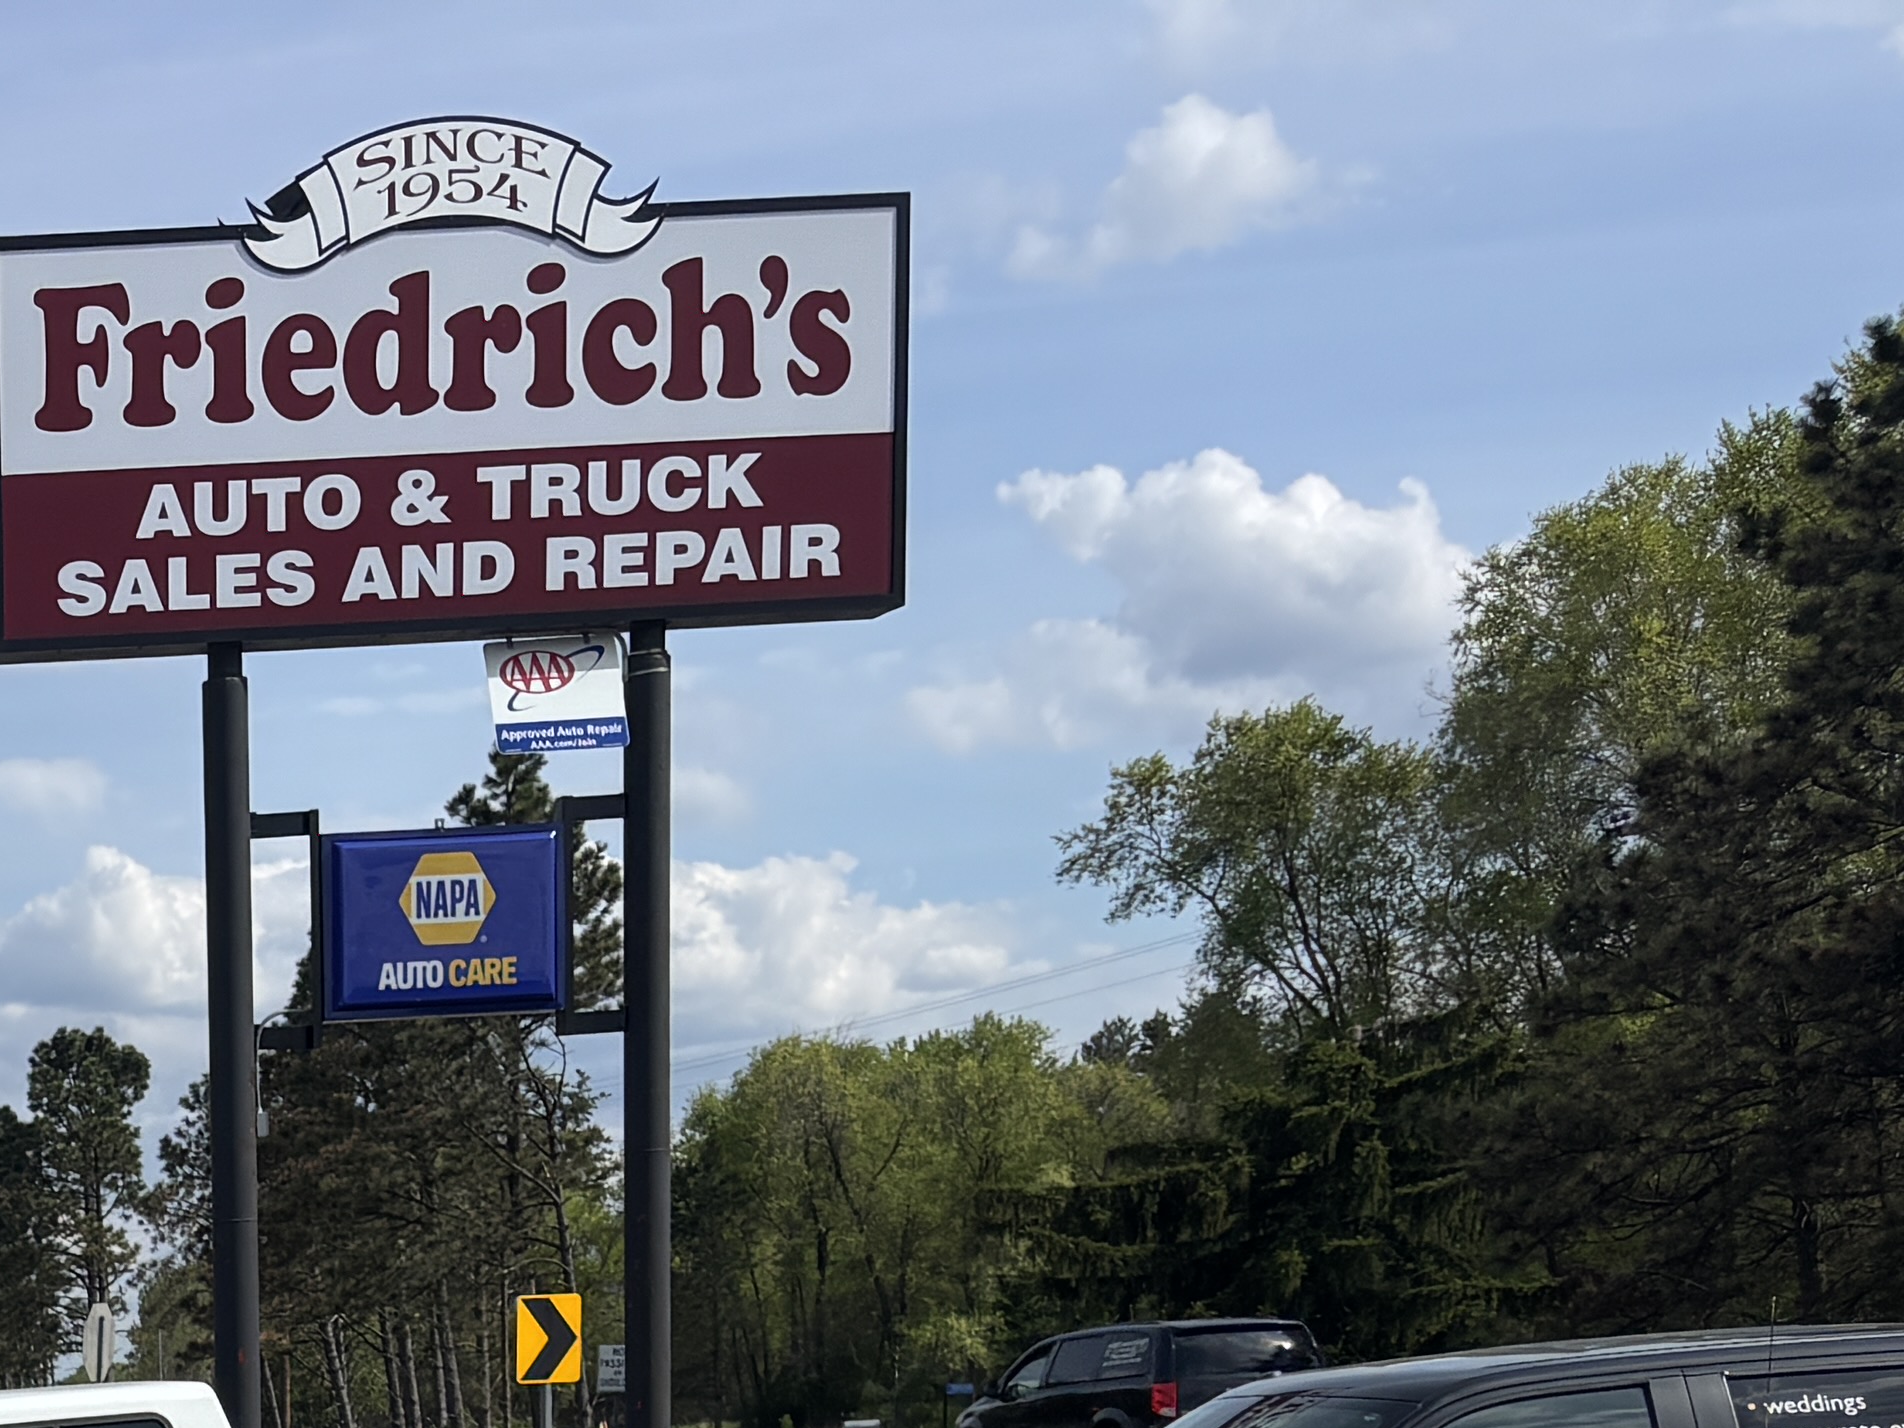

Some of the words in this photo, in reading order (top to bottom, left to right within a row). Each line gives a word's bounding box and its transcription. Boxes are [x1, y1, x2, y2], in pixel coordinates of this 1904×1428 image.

[352, 128, 552, 191] SINCE
[377, 164, 528, 220] 1954
[33, 253, 852, 433] Friedrich's
[135, 472, 362, 540] AUTO
[389, 466, 451, 526] &
[476, 450, 764, 524] TRUCK
[56, 549, 316, 620] SALES
[342, 537, 516, 603] AND
[544, 520, 841, 594] REPAIR
[510, 651, 568, 693] AAA
[501, 726, 555, 743] Approved
[556, 725, 584, 737] Auto
[415, 878, 481, 919] NAPA
[378, 960, 444, 991] AUTO
[448, 956, 518, 988] CARE
[1764, 1394, 1867, 1415] weddings
